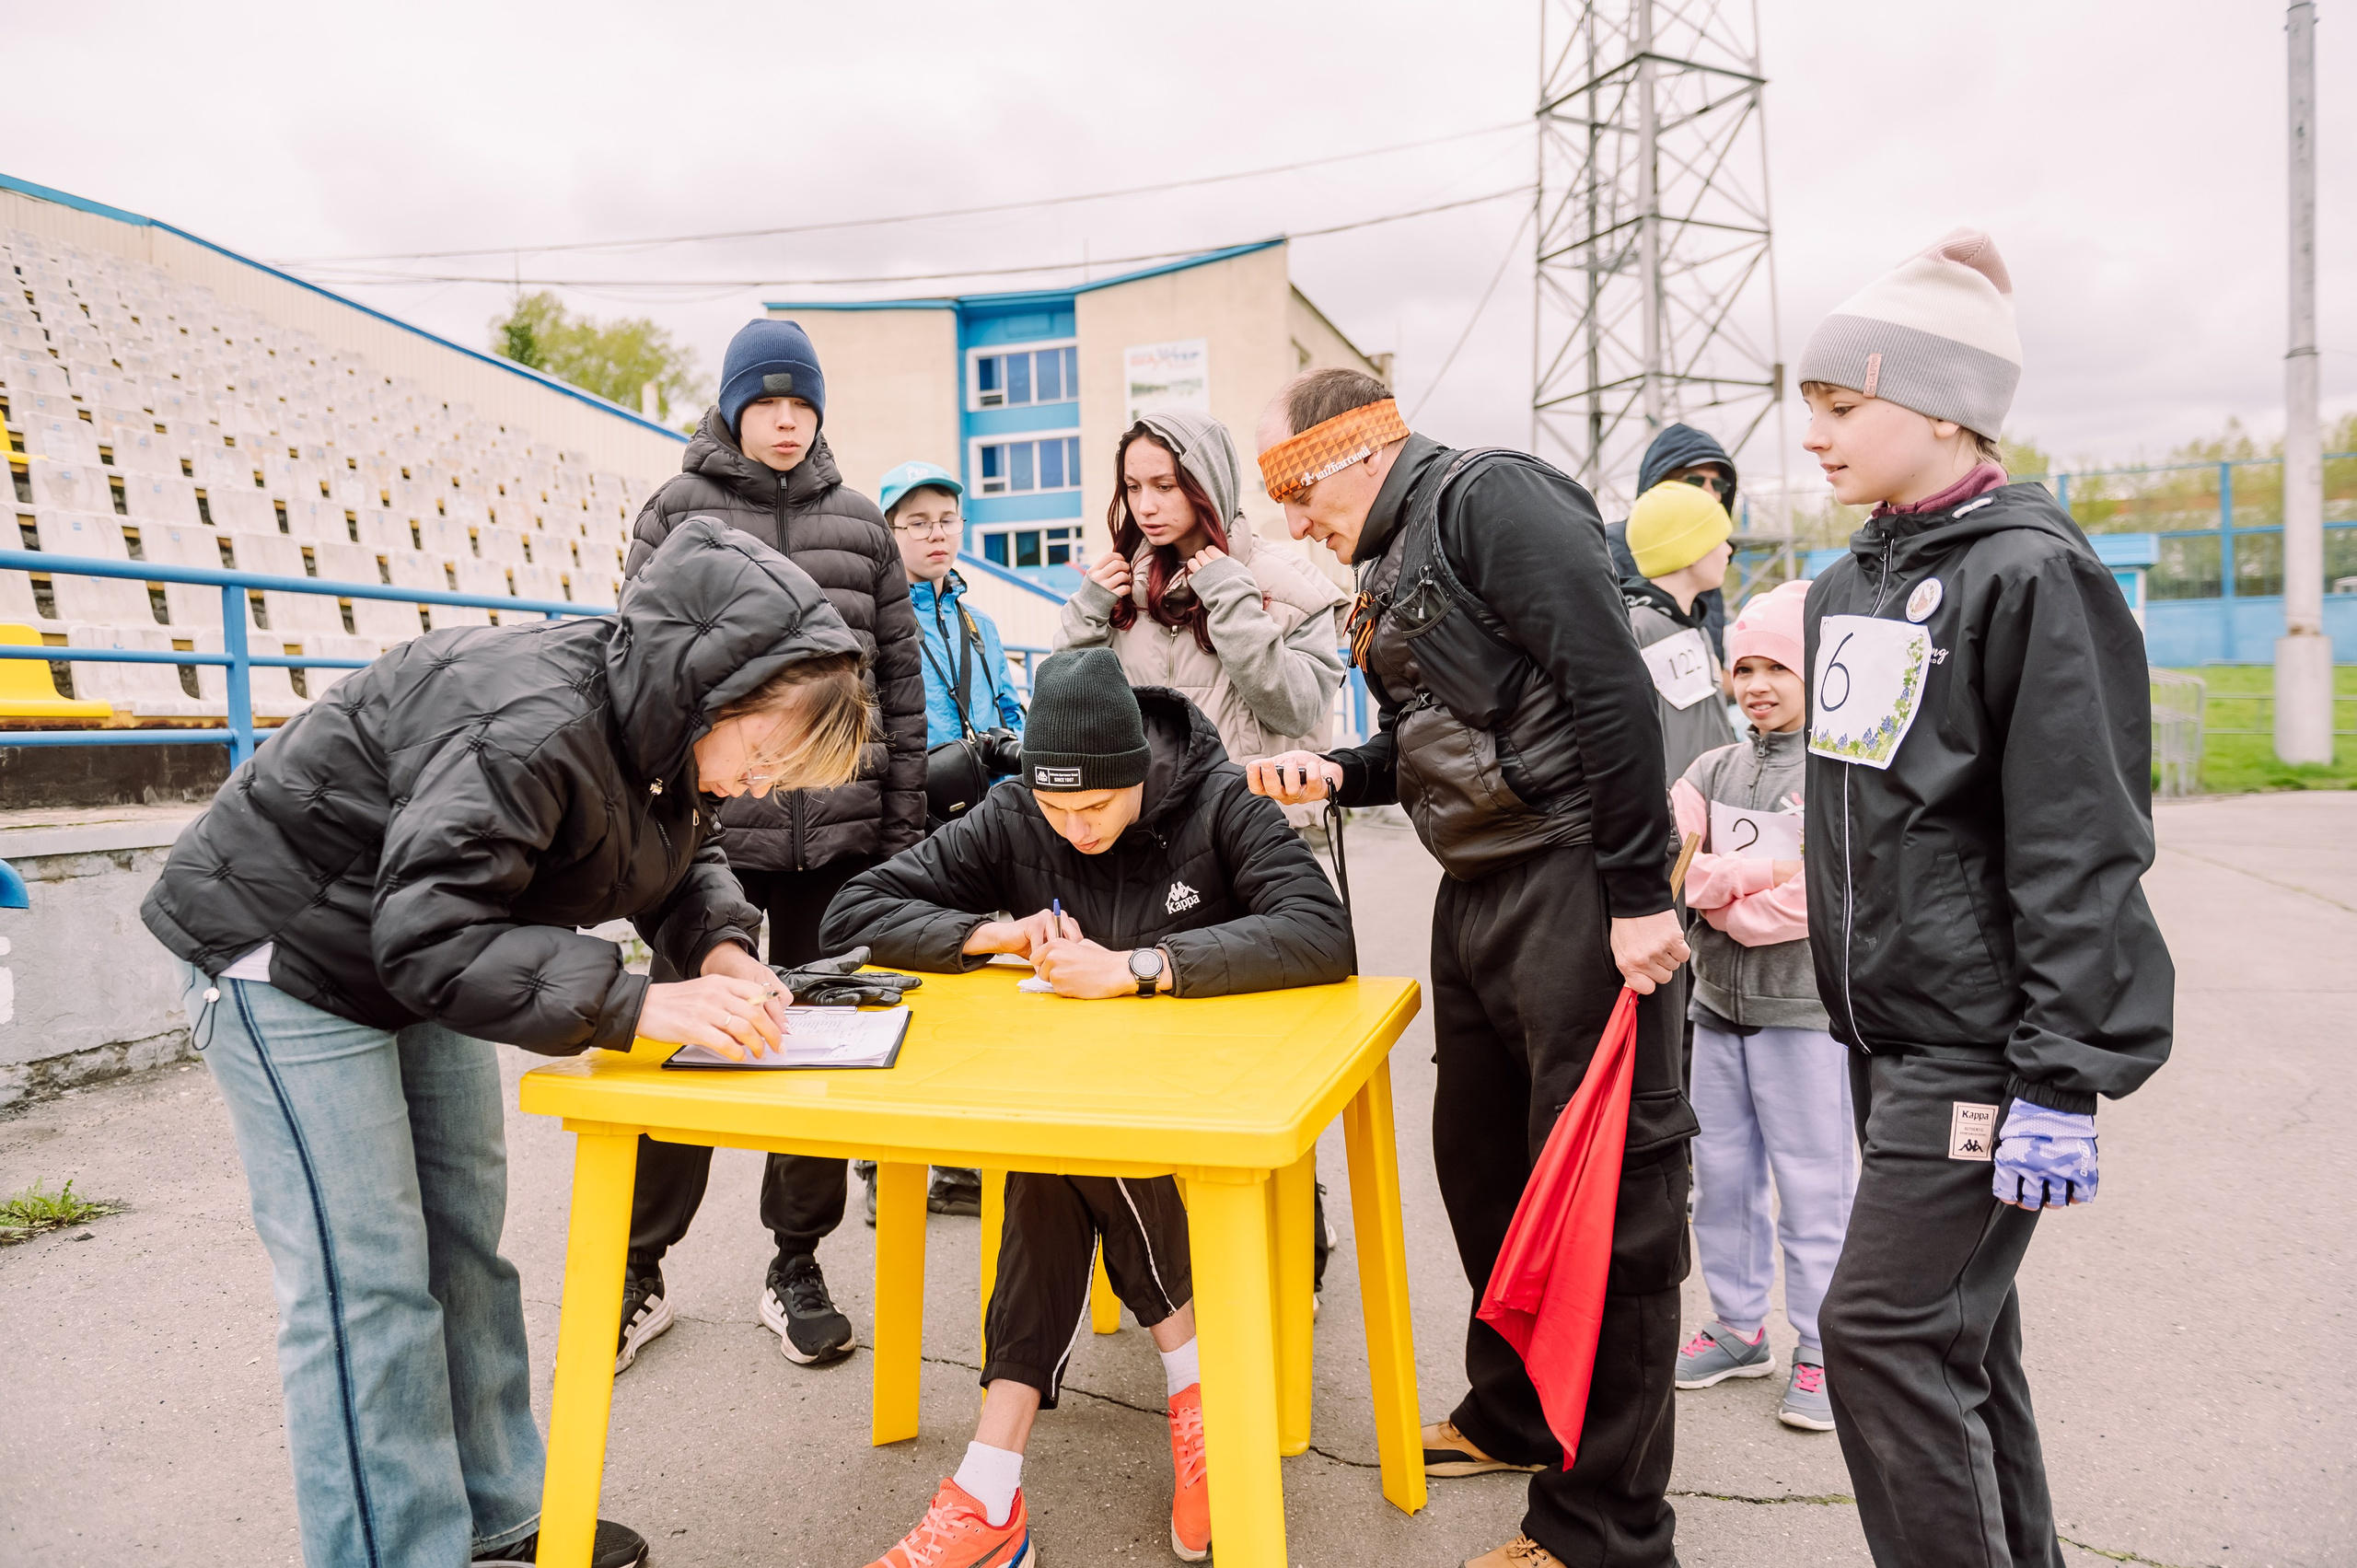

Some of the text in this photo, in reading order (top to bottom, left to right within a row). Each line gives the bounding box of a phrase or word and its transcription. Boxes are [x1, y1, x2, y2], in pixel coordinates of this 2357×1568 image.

[1667, 648, 1703, 680] 122
[1819, 632, 1854, 713] 6
[1732, 818, 1759, 852] 2
[1167, 894, 1202, 915] Kappa
[1962, 1109, 1990, 1121] Kappa
